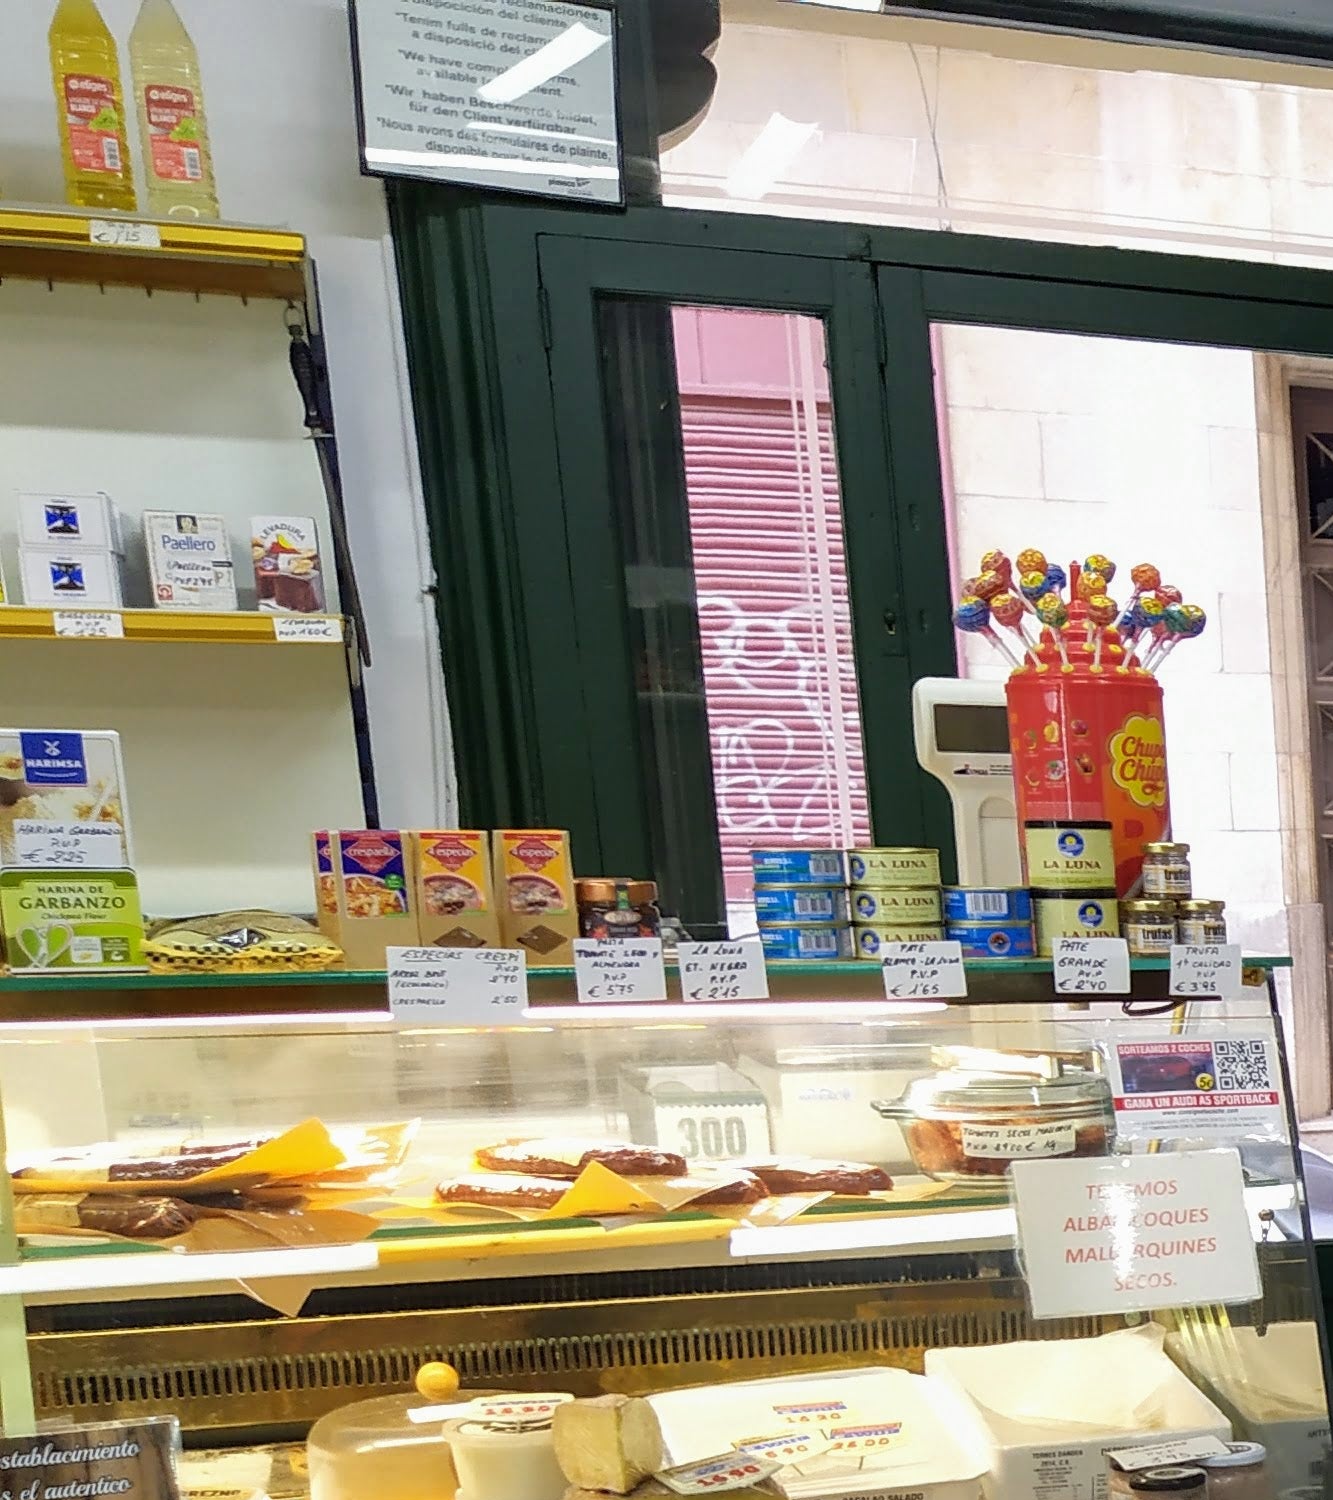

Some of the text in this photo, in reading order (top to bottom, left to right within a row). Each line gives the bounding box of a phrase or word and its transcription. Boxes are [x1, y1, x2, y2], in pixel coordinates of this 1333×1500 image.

[259, 522, 306, 543] LEVADURA
[161, 533, 217, 553] Paellero
[25, 757, 83, 770] HARIMSA
[869, 859, 927, 869] LA LUNA
[1043, 860, 1102, 870] LA LUNA
[37, 884, 104, 895] HARINA DE
[18, 896, 126, 910] GARBANZO
[881, 897, 935, 906] LA LUNA
[885, 933, 903, 943] LA
[1142, 927, 1173, 941] trufas
[1117, 1043, 1212, 1055] SORTEAMOS 2 COCHES
[1123, 1093, 1273, 1110] GANA UN AUDI A5 SPORTBACK
[676, 1116, 749, 1159] 300
[1114, 1272, 1178, 1292] SECOS.
